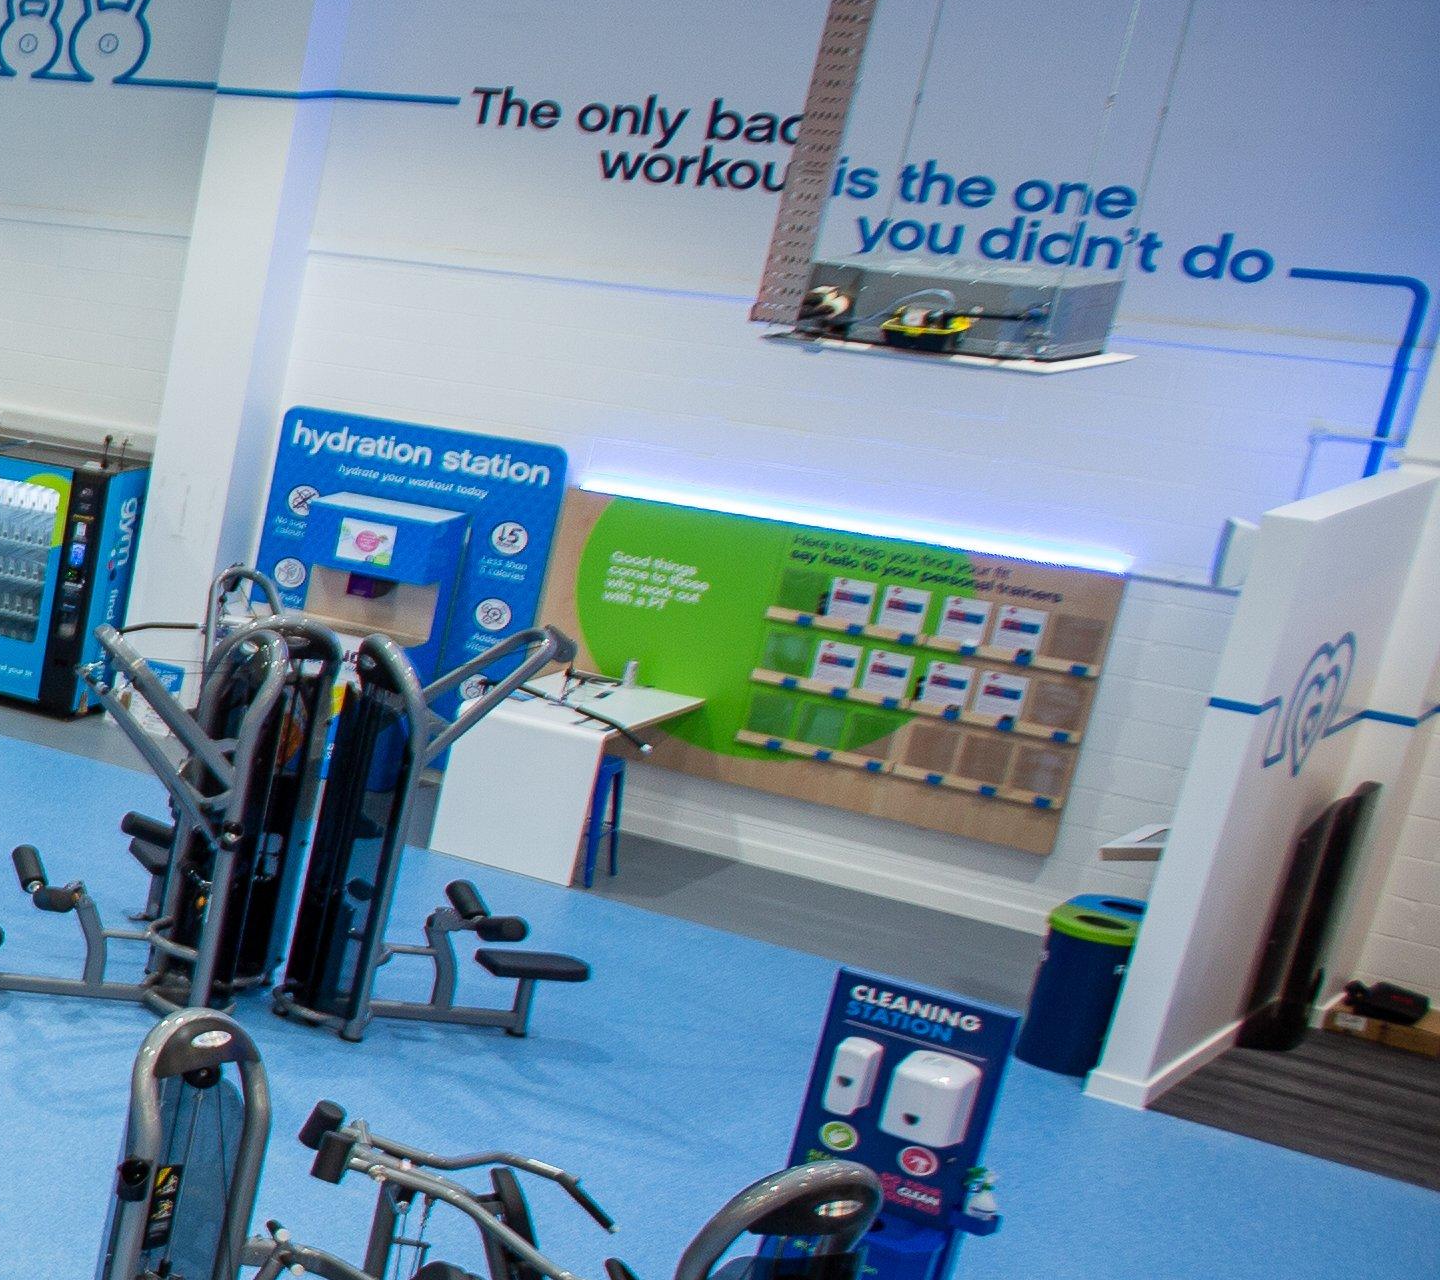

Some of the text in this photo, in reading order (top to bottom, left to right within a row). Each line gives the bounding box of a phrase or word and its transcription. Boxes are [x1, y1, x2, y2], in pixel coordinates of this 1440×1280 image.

[472, 86, 562, 131] The
[576, 94, 689, 149] only
[599, 147, 792, 194] workou
[831, 156, 1140, 220] is the one
[854, 211, 1276, 285] you didn't do
[292, 419, 552, 487] hydration station
[608, 565, 649, 580] come
[651, 571, 666, 583] to
[611, 550, 698, 577] Good things
[821, 551, 859, 569] hello
[861, 559, 879, 572] to
[880, 566, 919, 578] your
[920, 571, 995, 591] personal
[995, 582, 1064, 603] trainers
[602, 590, 666, 609] with a PT
[605, 578, 699, 603] who work out
[846, 999, 954, 1044] STATION
[850, 983, 982, 1032] CLEANING
